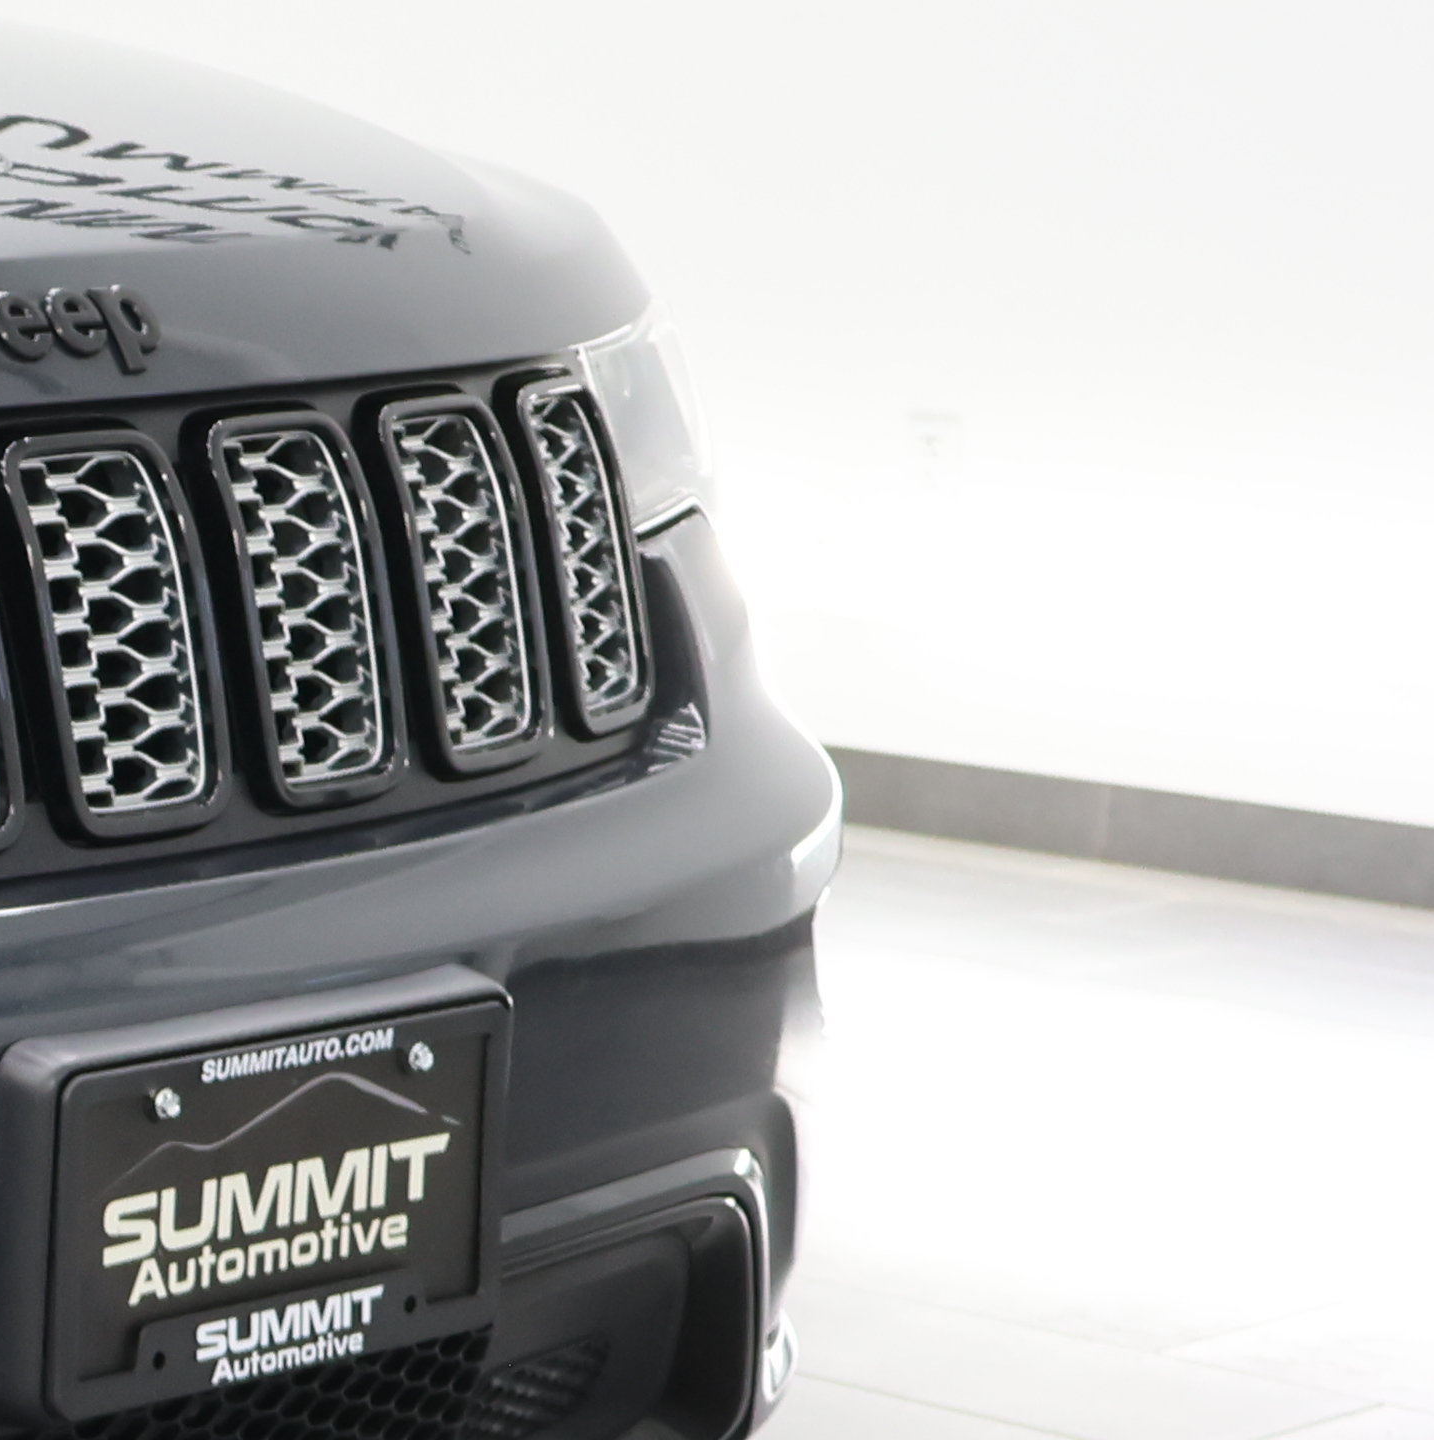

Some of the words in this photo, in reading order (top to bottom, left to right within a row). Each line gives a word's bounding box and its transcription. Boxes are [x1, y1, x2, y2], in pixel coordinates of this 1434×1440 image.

[200, 1027, 395, 1083] SUMMITAUTO.COM
[102, 1132, 451, 1267] SUMMIT
[128, 1213, 408, 1307] Automotive
[195, 1284, 385, 1362] SUMMIT
[210, 1332, 364, 1386] Automotive
